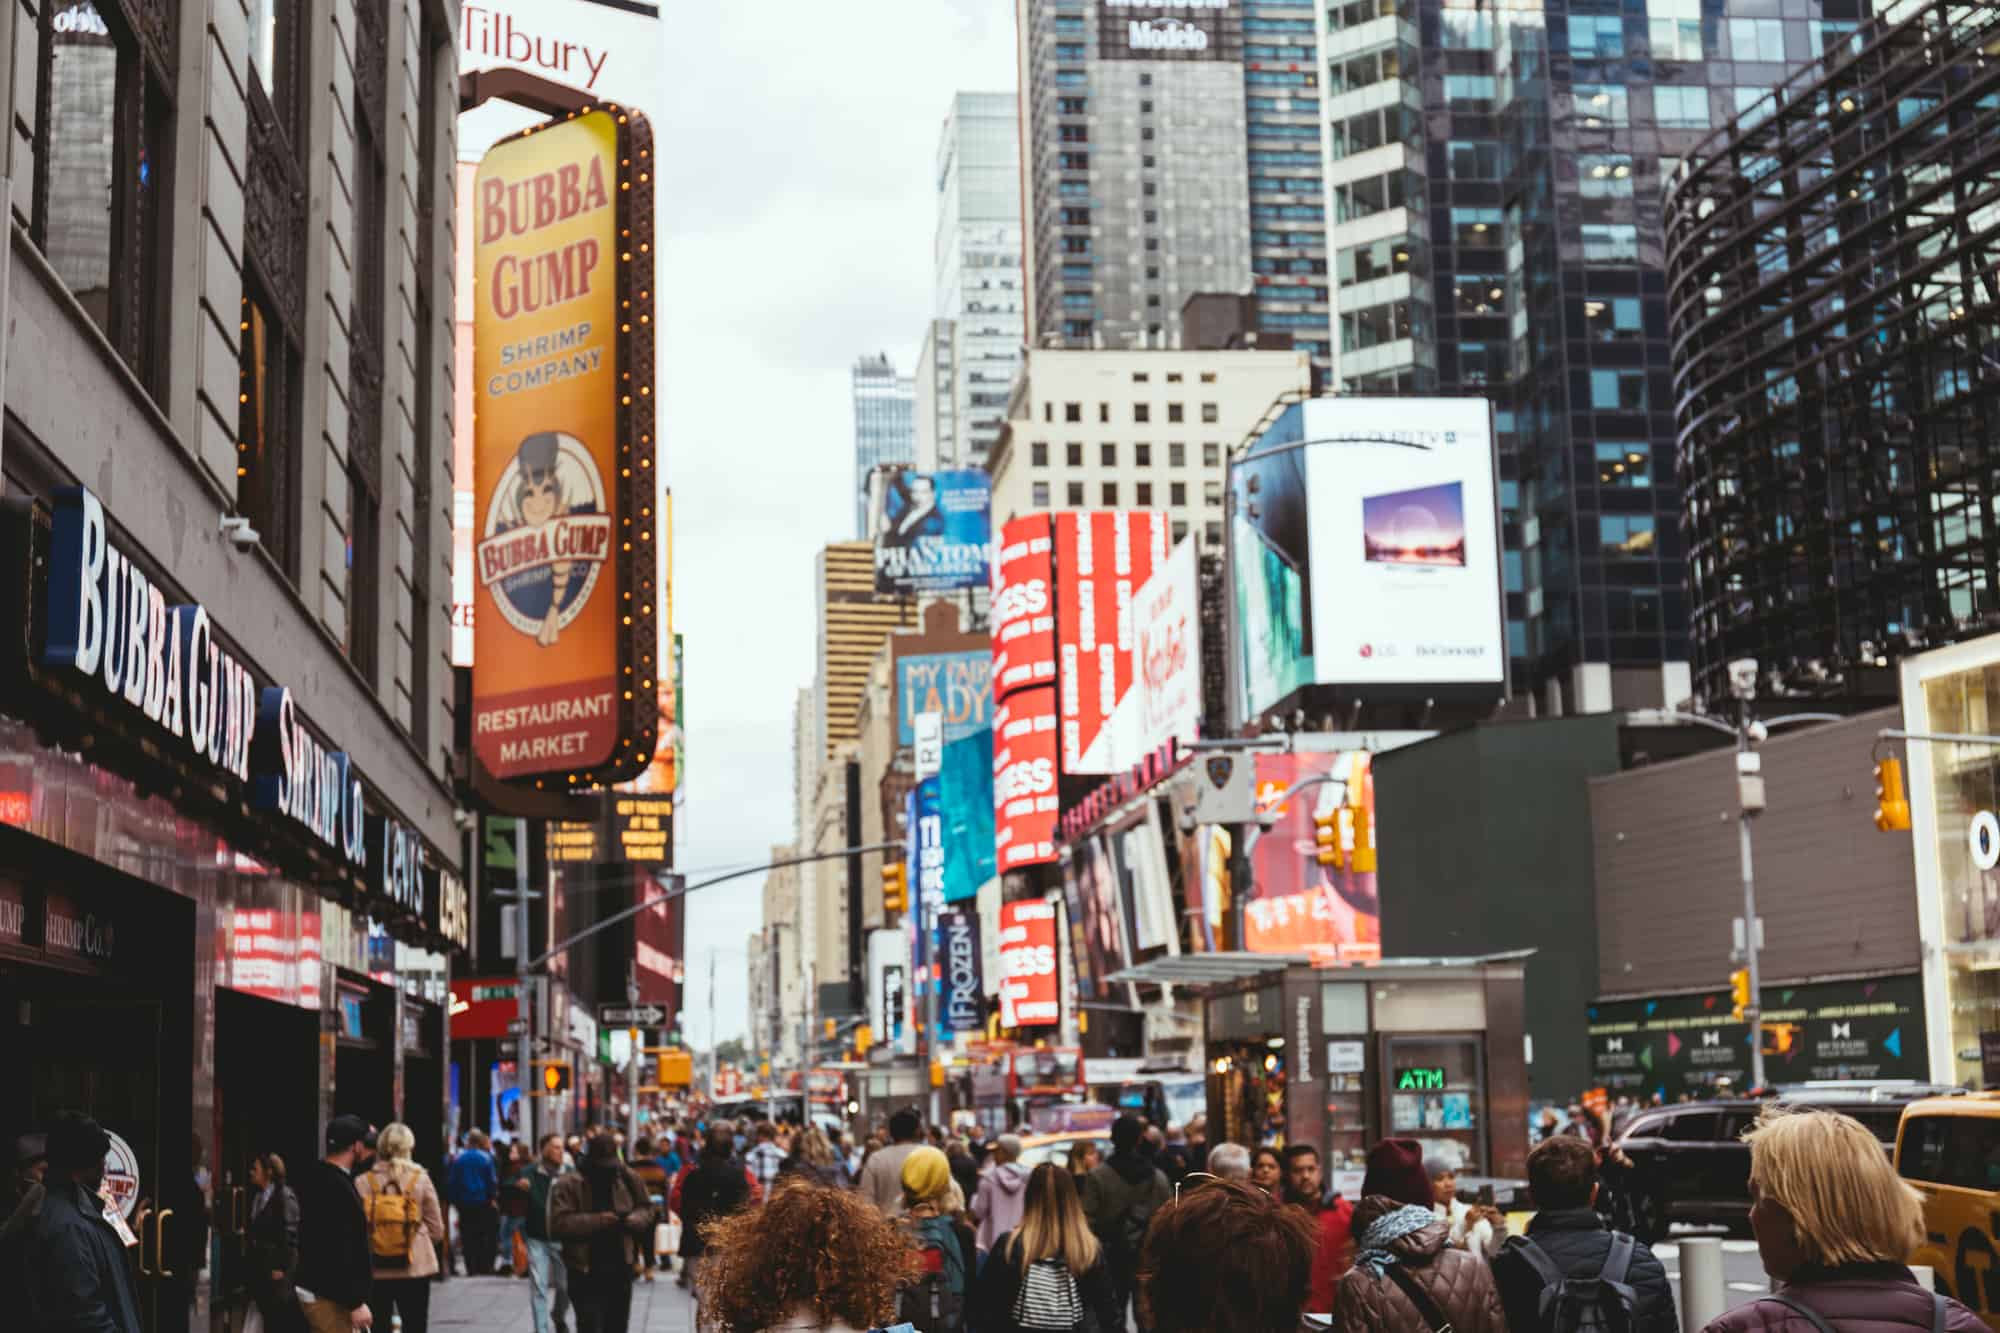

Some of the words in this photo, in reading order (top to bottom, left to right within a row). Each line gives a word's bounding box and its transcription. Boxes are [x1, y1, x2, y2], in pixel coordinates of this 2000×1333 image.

[463, 7, 608, 89] Tilbury
[1128, 20, 1208, 49] Modelo
[481, 154, 609, 246] BUBBA
[491, 239, 599, 320] GUMP
[501, 322, 592, 366] SHRIMP
[488, 347, 605, 397] COMPANY
[483, 527, 549, 579] BUBBA
[554, 519, 608, 557] GUMP
[875, 542, 991, 569] PHANTOM
[75, 486, 184, 738] BUBBA
[189, 604, 256, 782] GUMP
[278, 686, 340, 848] SHRIMP
[477, 693, 613, 734] RESTAURANT
[906, 686, 991, 727] LADY
[500, 730, 589, 763] MARKET
[949, 924, 979, 1017] FROZEN
[1399, 1068, 1443, 1089] ATM
